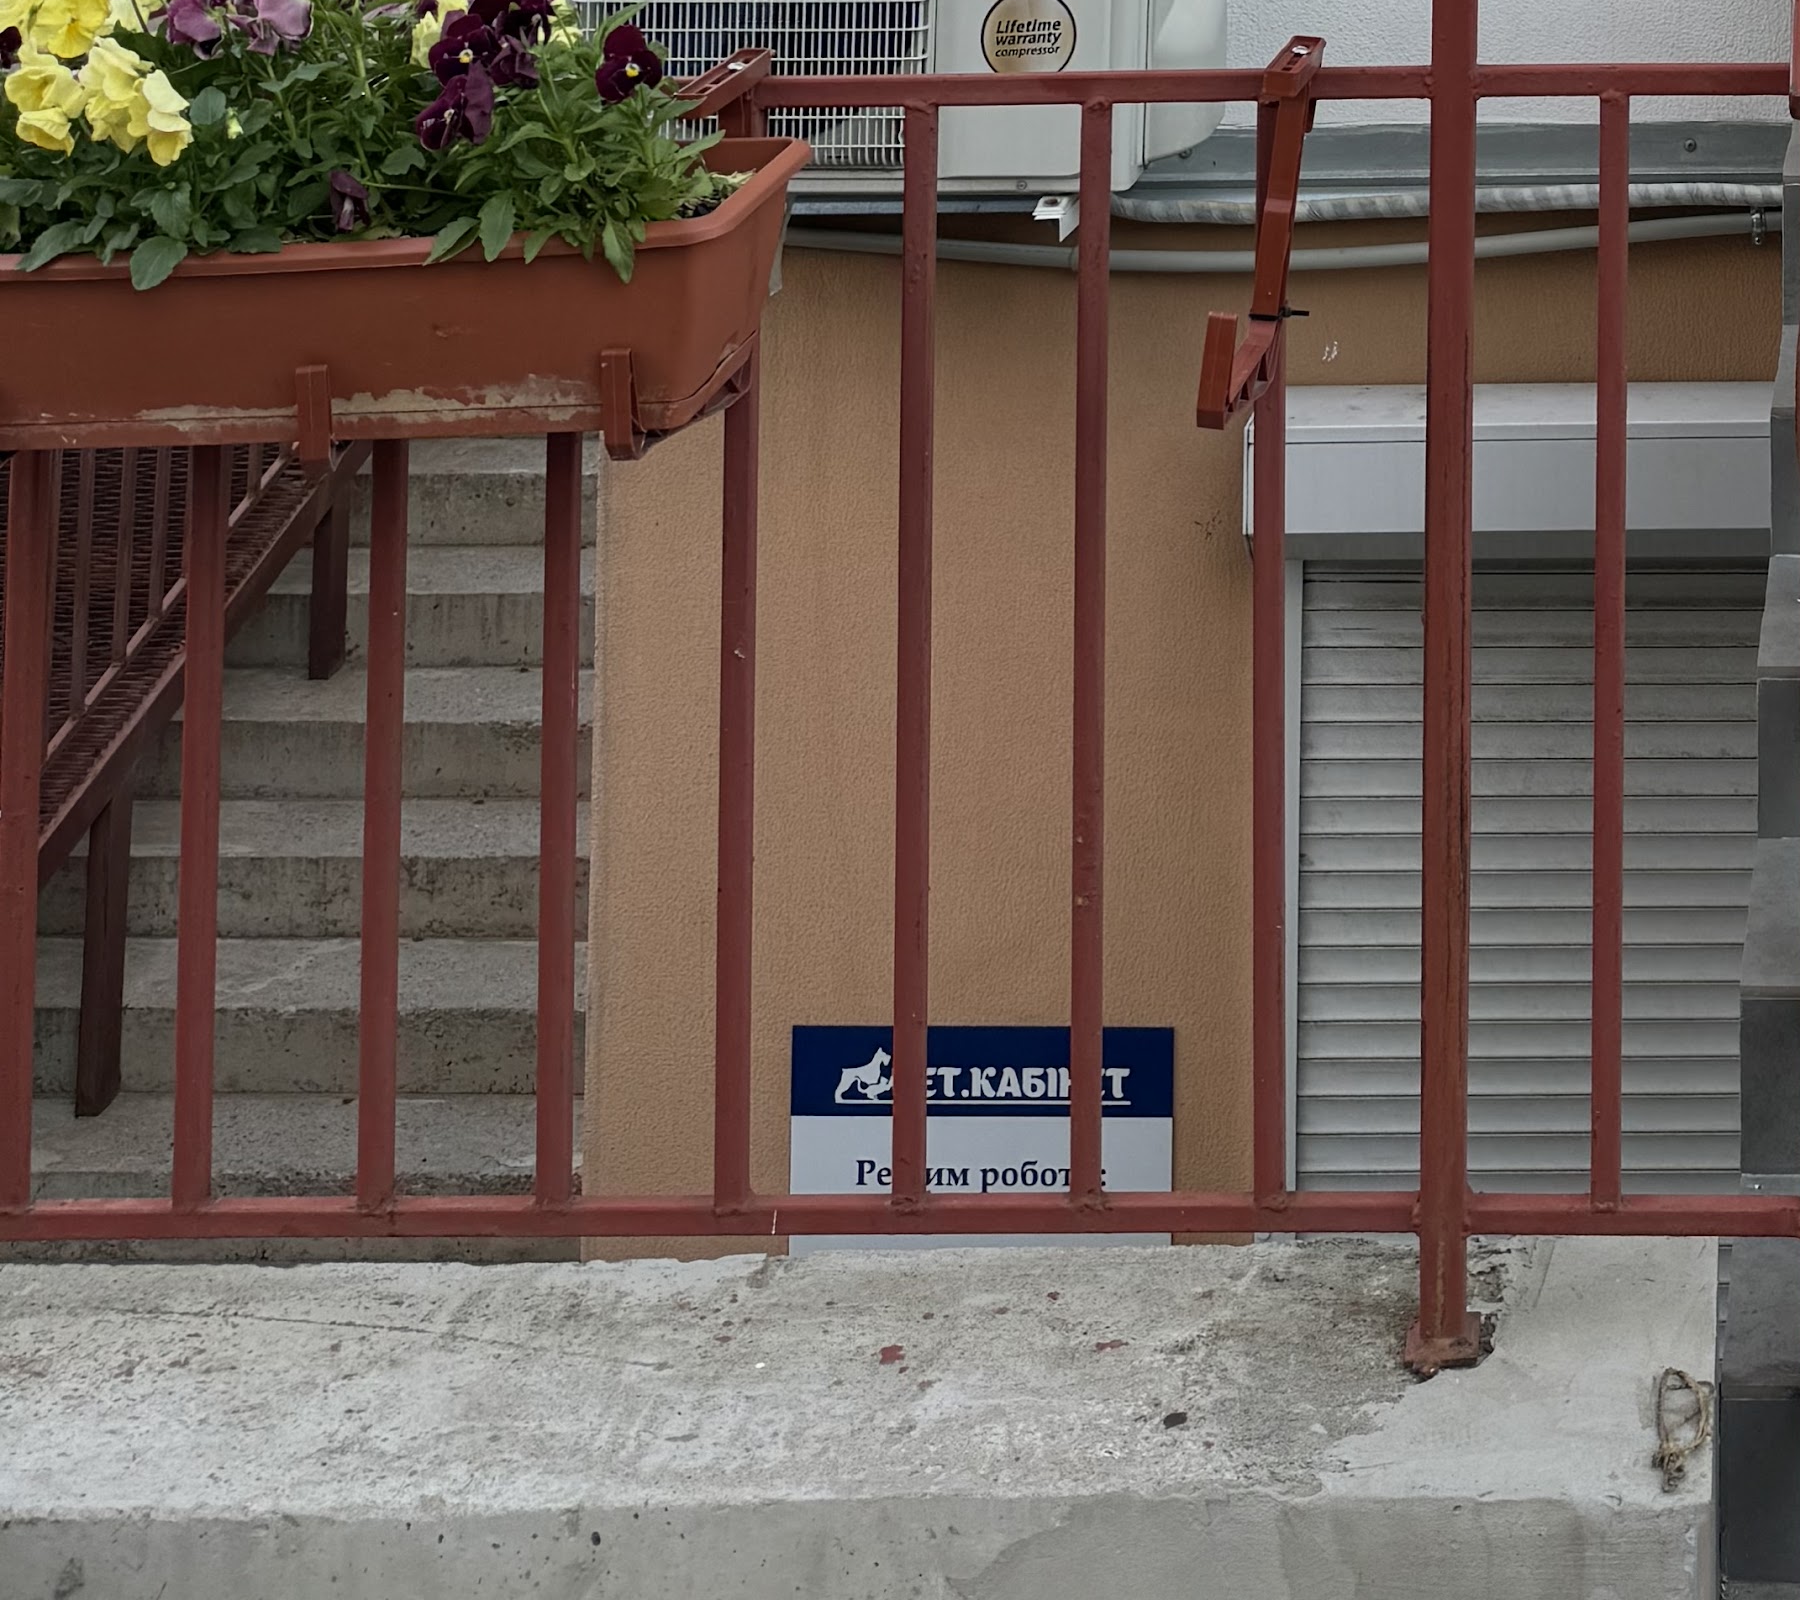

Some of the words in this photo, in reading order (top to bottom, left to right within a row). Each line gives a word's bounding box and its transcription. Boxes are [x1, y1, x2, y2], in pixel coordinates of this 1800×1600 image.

[996, 18, 1062, 34] Lifetime
[995, 31, 1062, 47] warranty
[995, 45, 1061, 58] compressor
[855, 1159, 970, 1187] Реим
[980, 1160, 1107, 1193] робот:
